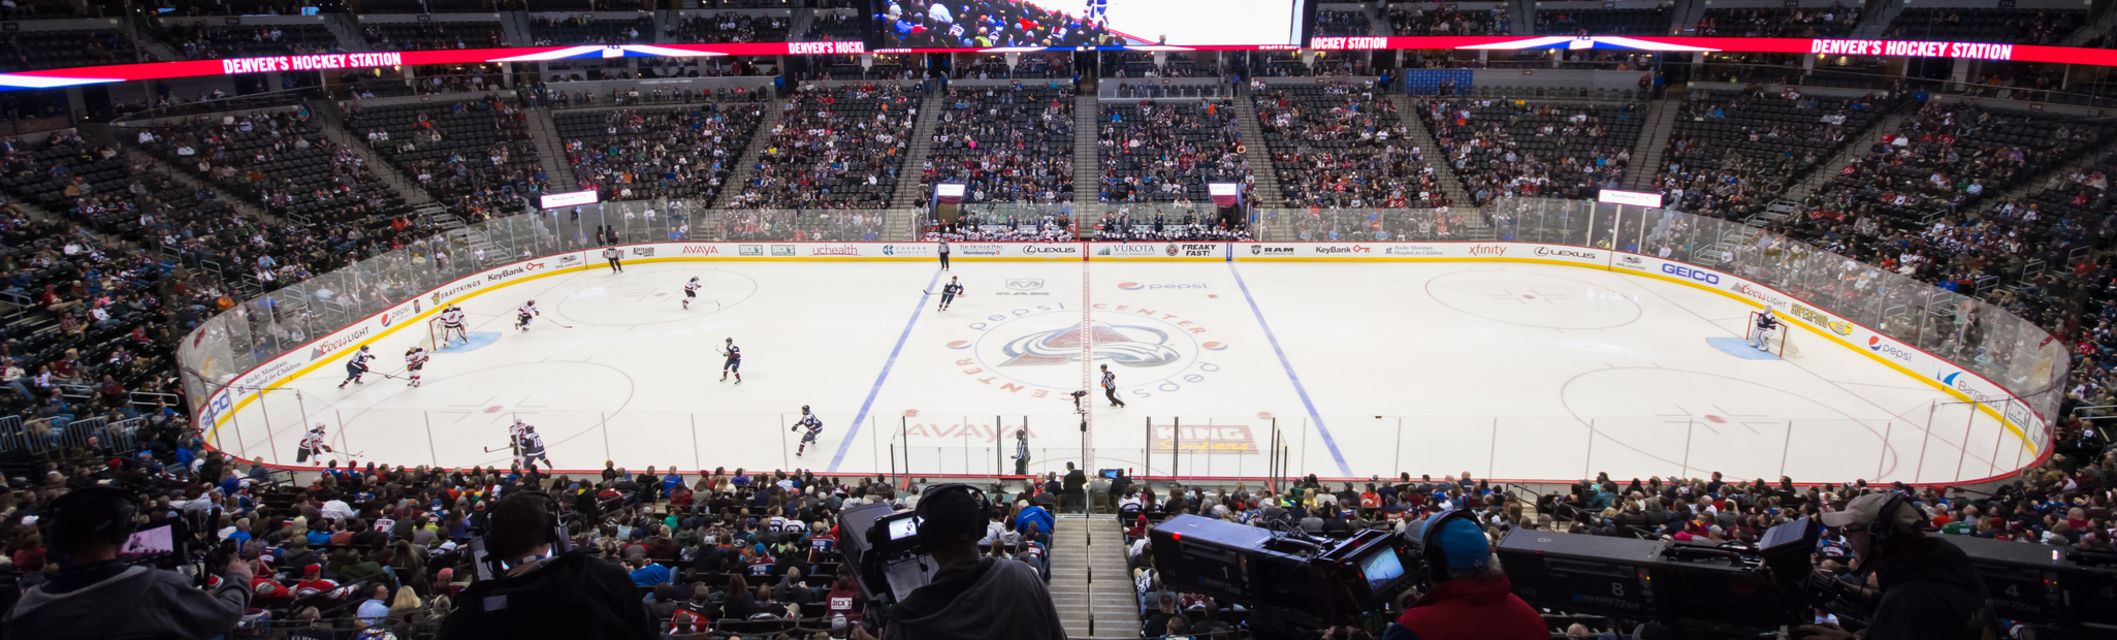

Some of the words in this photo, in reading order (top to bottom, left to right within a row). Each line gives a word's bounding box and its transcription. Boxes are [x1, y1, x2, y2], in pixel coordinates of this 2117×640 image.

[788, 41, 834, 54] DENVER'S
[1348, 37, 1387, 50] STATION
[1811, 39, 1882, 55] DENVER'S
[1886, 41, 1948, 57] HOCKEY
[1951, 42, 2012, 60] STATION
[223, 56, 290, 74] DENVER'S
[292, 54, 347, 71] HOCKEY
[350, 52, 401, 67] STATION
[682, 245, 719, 256] AVAYA
[813, 244, 858, 256] uchealth
[1113, 244, 1155, 253] VUKOTA
[1315, 246, 1351, 254] KeyBank
[1468, 245, 1507, 256] xfinity
[1550, 250, 1596, 259] LEXUS
[487, 266, 525, 282] KeyBank
[1662, 263, 1719, 285] GEICO
[440, 279, 481, 299] DRAFTKINGS
[1741, 283, 1766, 301] Coors
[1766, 295, 1787, 308] LIGHT
[1092, 303, 1207, 334] CENTER
[319, 338, 347, 355] Coors
[347, 326, 370, 343] LIGHT
[1882, 342, 1912, 362] pepsi
[903, 423, 1037, 443] AVAYA
[1222, 566, 1229, 579] 1
[1611, 582, 1625, 597] 8
[2004, 583, 2020, 598] 4
